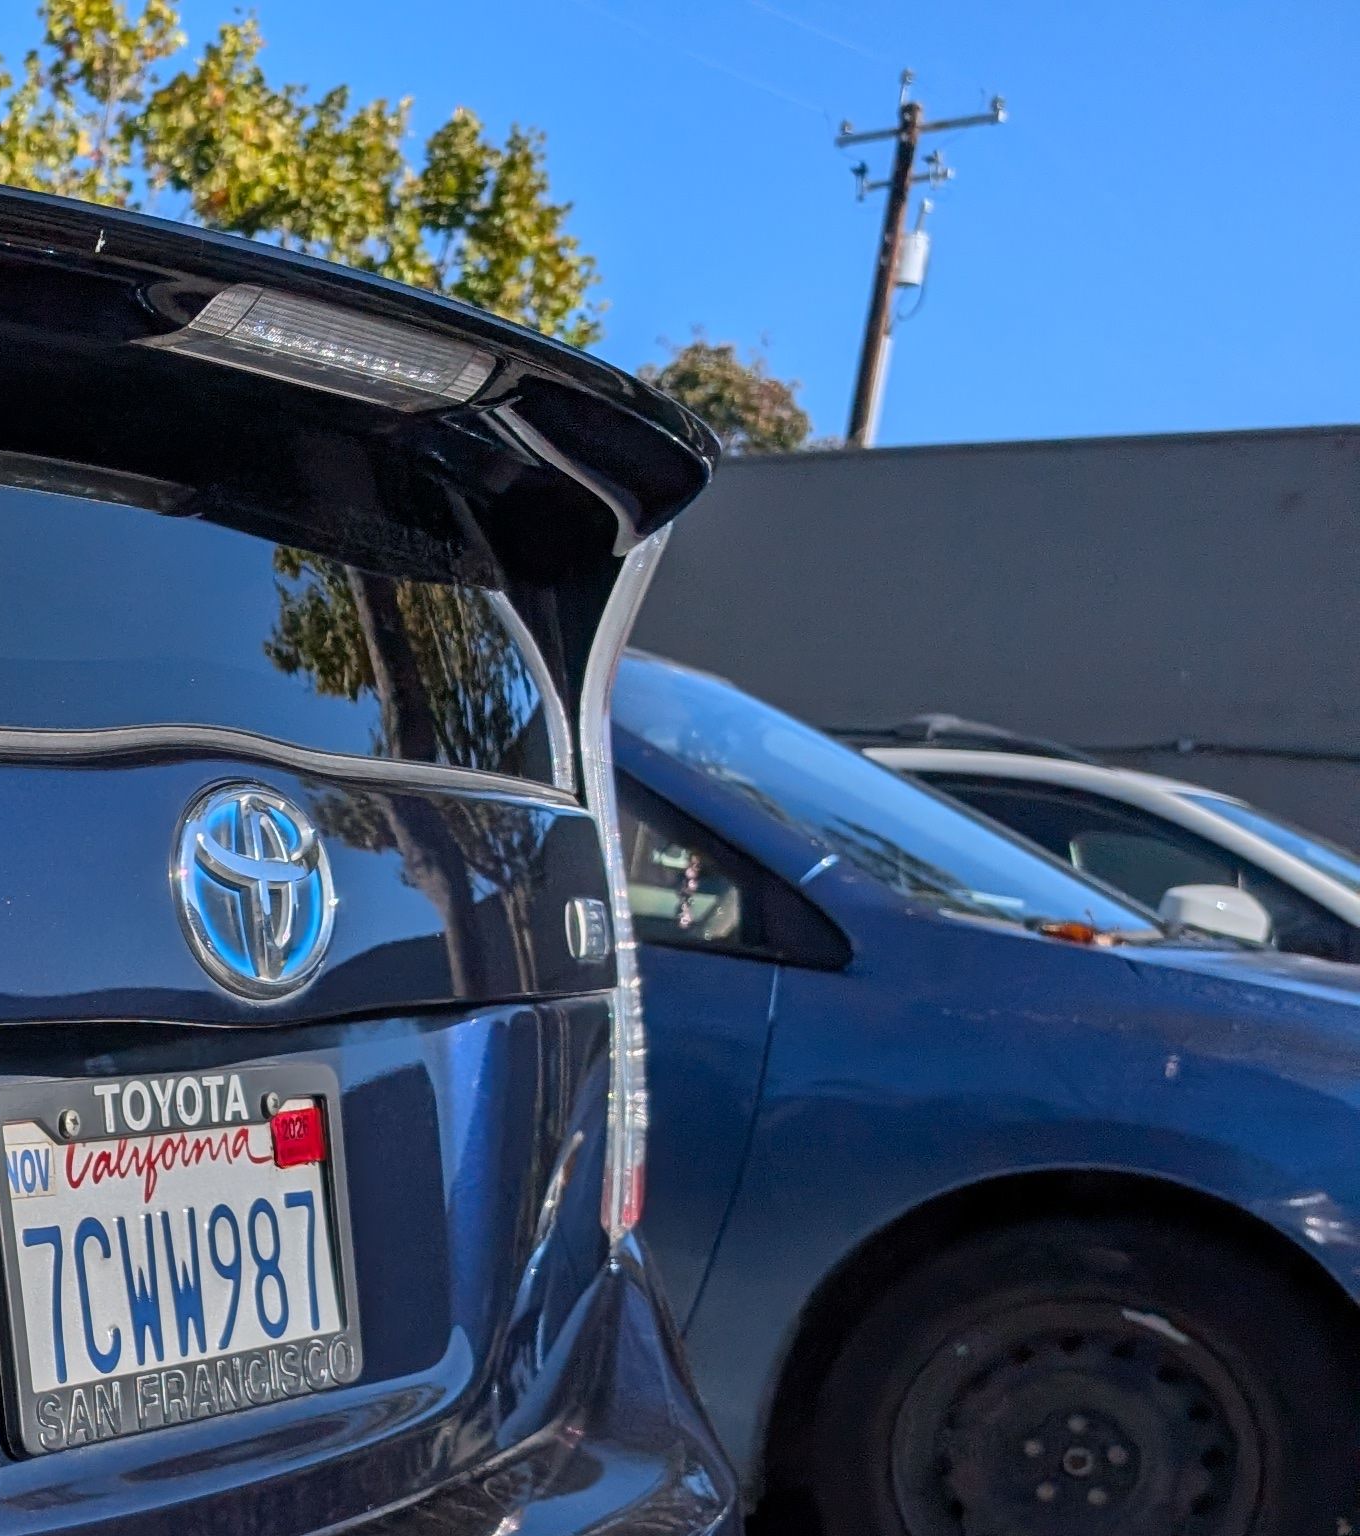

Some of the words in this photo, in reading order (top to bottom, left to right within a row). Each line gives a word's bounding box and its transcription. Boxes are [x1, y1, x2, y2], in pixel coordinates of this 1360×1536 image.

[94, 1074, 250, 1133] TOYOTA
[6, 1147, 50, 1195] NOV
[66, 1128, 272, 1203] California
[23, 1191, 320, 1384] 7CWW987
[37, 1383, 122, 1451] SAN
[137, 1333, 355, 1432] FRANCISCO
